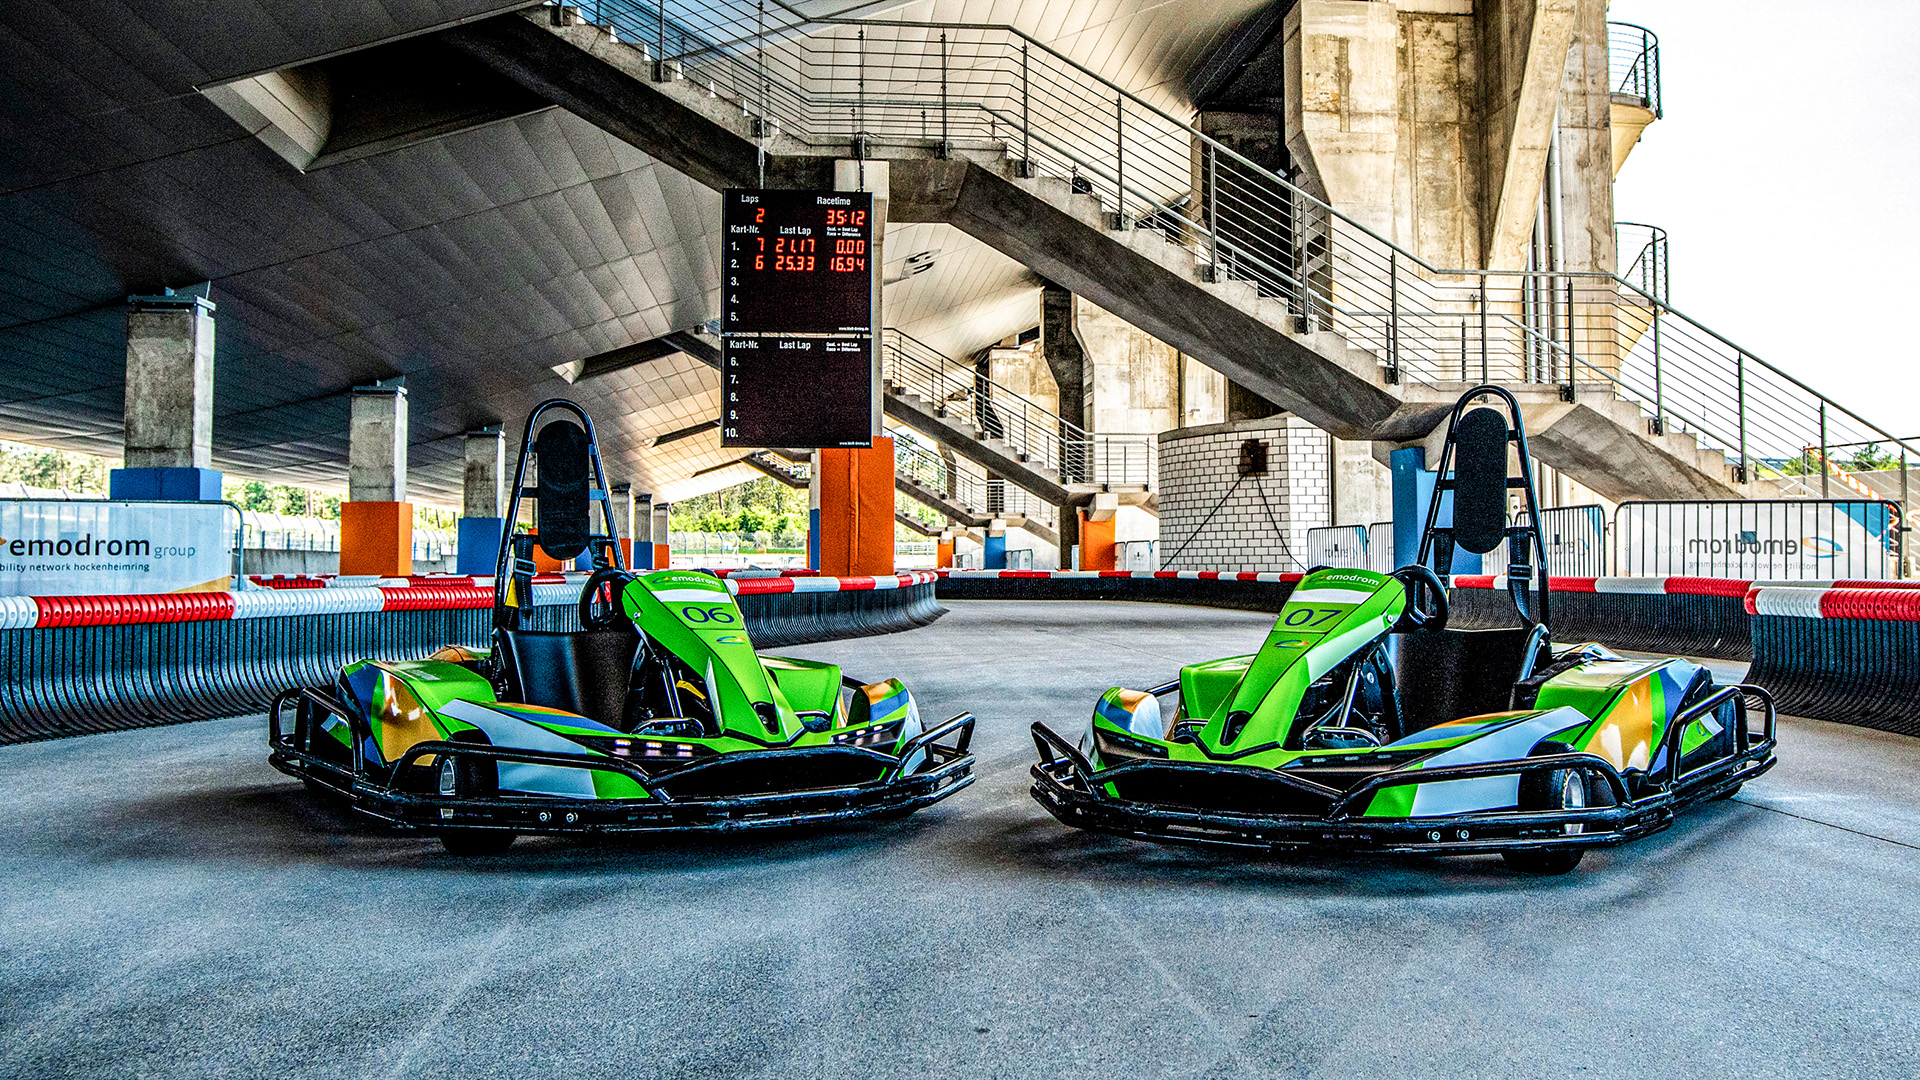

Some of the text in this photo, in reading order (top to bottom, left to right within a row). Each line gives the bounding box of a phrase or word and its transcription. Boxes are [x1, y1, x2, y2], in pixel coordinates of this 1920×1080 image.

[741, 194, 759, 204] Laps
[816, 196, 851, 205] Racetime
[756, 208, 765, 223] 2
[826, 210, 866, 226] 35:12
[730, 225, 760, 234] Kart-Nr.
[779, 226, 812, 236] Last Lap
[731, 242, 740, 251] 1.
[757, 238, 815, 253] 7 21.17
[835, 239, 865, 255] 0.00
[731, 260, 740, 268] 2.
[755, 255, 815, 271] 6 25.33
[830, 257, 865, 272] 16.94
[731, 277, 739, 286] 3.
[731, 295, 739, 304] 4.
[731, 313, 739, 322] 5.
[729, 341, 759, 349] Kart-Nr.
[779, 341, 811, 351] Last Lap
[730, 357, 739, 366] 6.
[730, 375, 739, 384] 7.
[730, 393, 739, 402] 8.
[730, 410, 739, 419] 9.
[724, 429, 739, 437] 10.
[9, 534, 196, 558] emodrom group
[30, 563, 70, 571] network
[74, 563, 150, 572] hockenheimring
[672, 576, 720, 587] emodrom
[1326, 574, 1380, 586] emodrom
[682, 606, 734, 624] 06
[1284, 608, 1342, 627] 07
